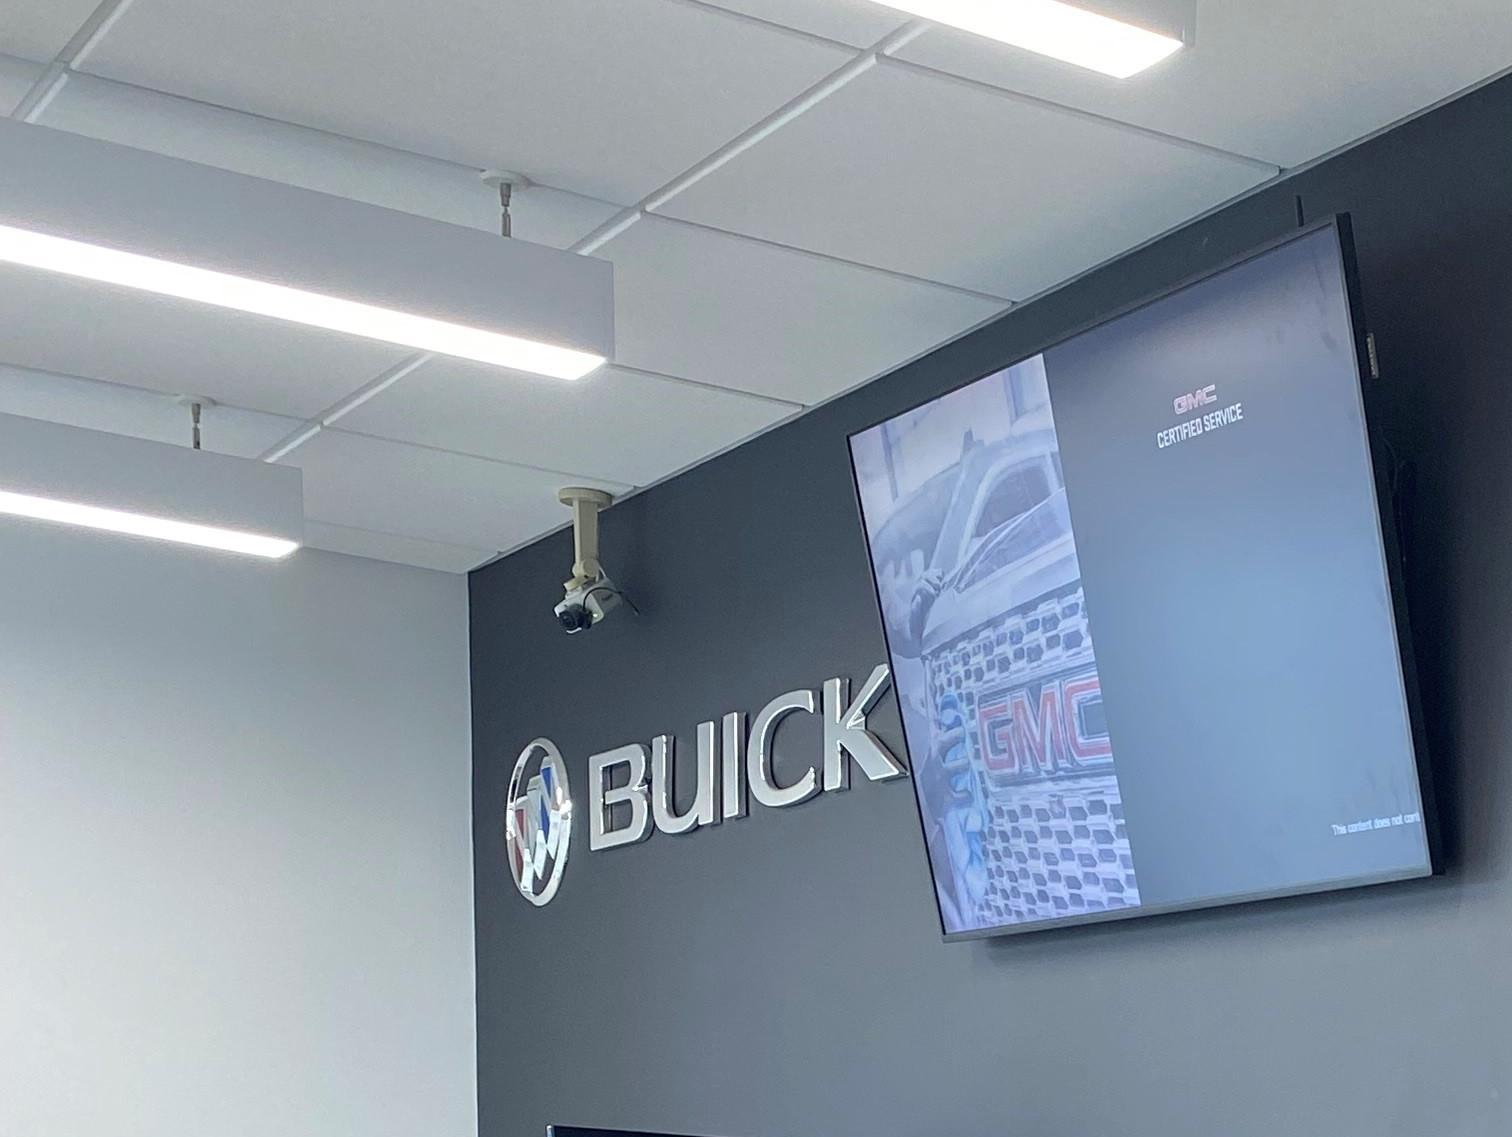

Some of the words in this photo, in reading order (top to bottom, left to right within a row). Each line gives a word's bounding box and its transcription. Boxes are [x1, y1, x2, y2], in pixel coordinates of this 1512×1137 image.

[1157, 417, 1203, 449] CERTIFIED
[1203, 403, 1244, 432] SERVICE
[1173, 384, 1217, 415] GMC
[588, 663, 908, 852] BUICK
[976, 677, 1113, 777] GMC
